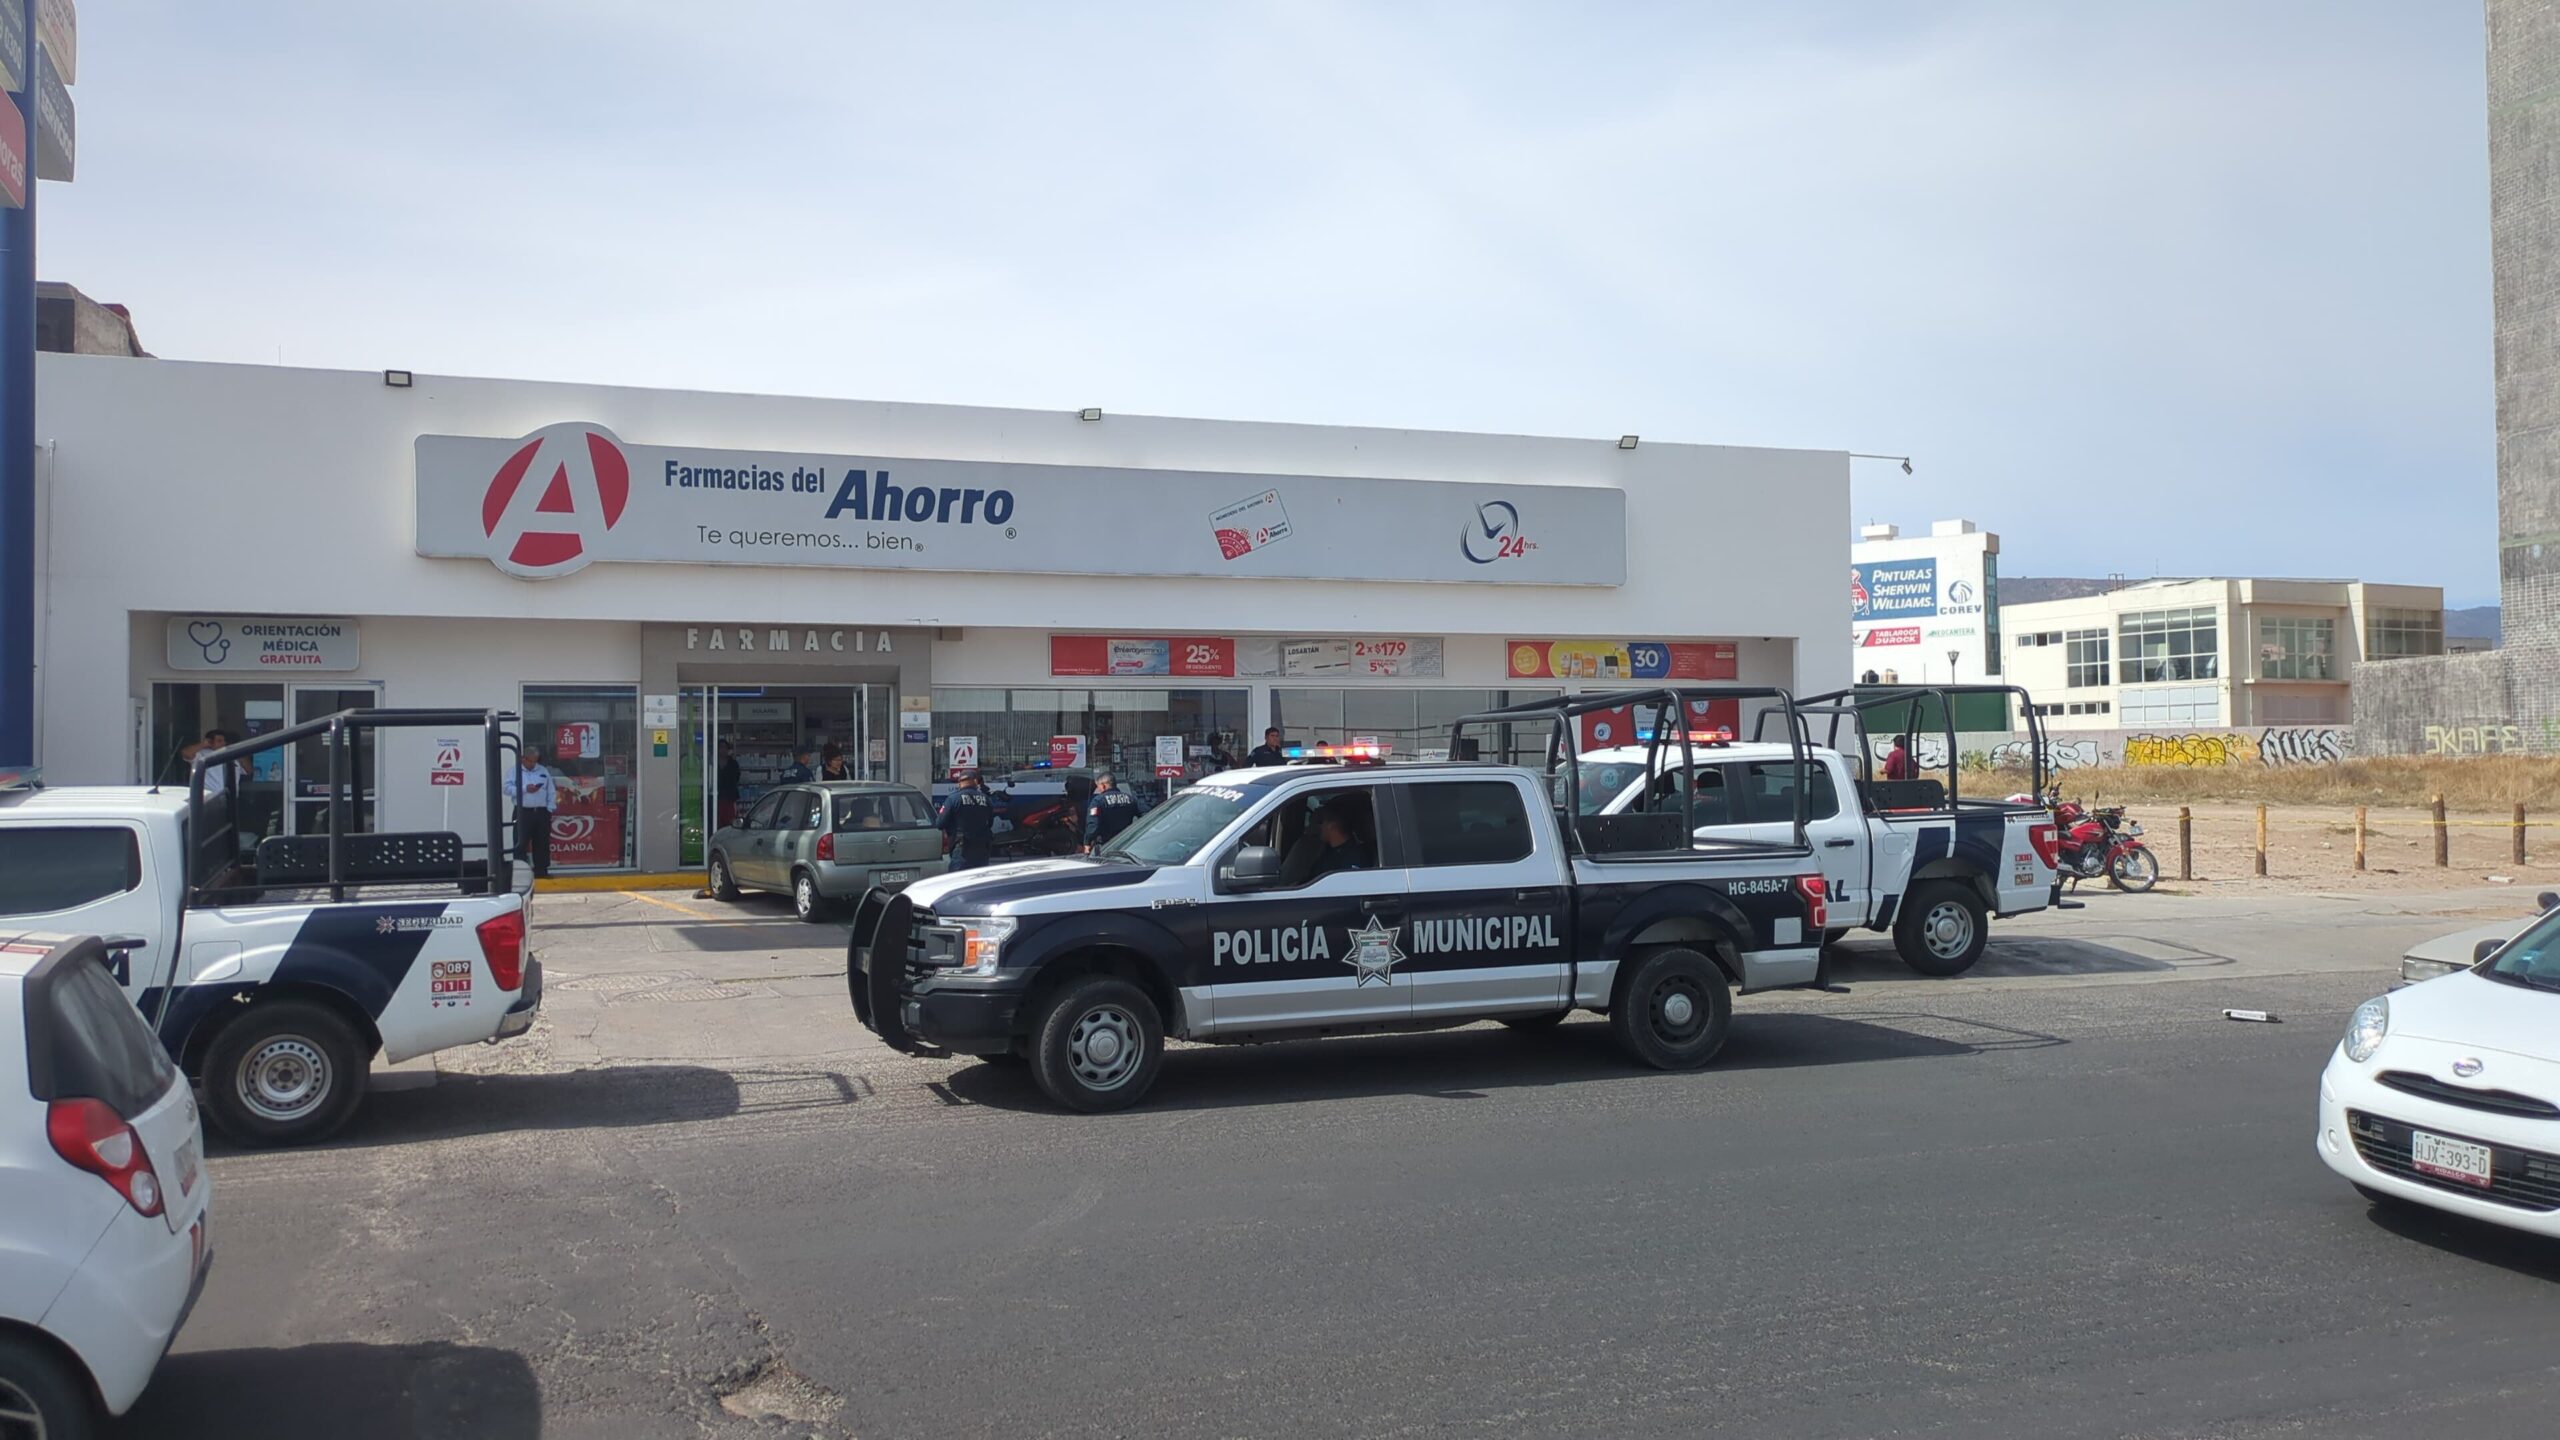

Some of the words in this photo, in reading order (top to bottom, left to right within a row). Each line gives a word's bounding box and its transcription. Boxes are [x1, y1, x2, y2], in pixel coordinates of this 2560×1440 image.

[0, 134, 24, 188] oras
[665, 460, 784, 492] Farmacias
[791, 467, 825, 493] del
[825, 469, 1015, 525] Ahorro
[697, 525, 722, 545] Te
[729, 528, 860, 550] queremos...
[1498, 535, 1524, 557] 24
[1872, 568, 1933, 583] PINTURAS
[1872, 583, 1931, 597] SHERWIN
[1872, 597, 1935, 611] WILLIAMS.
[1940, 605, 1982, 615] COREV
[241, 624, 341, 637] ORIENTACIÓN
[1874, 629, 1919, 637] TABLAROCA
[262, 638, 319, 652] MÉDICA
[687, 628, 893, 652] FARMACIA
[1874, 637, 1916, 645] DUROCK
[1186, 645, 1220, 664] 25%
[1288, 647, 1320, 656] LOSARTÁN
[1355, 642, 1365, 656] 2
[1375, 642, 1407, 656] $179
[259, 655, 322, 665] GRATUITA
[550, 843, 594, 852] OLANDA
[1728, 878, 1788, 895] HG-845A-7
[398, 916, 463, 926] SEGURIDAD
[1213, 920, 1330, 966] POLICÍA
[1413, 915, 1560, 954] MUNICIPAL
[447, 962, 469, 974] 089
[2415, 1141, 2486, 1175] HJX-393-D
